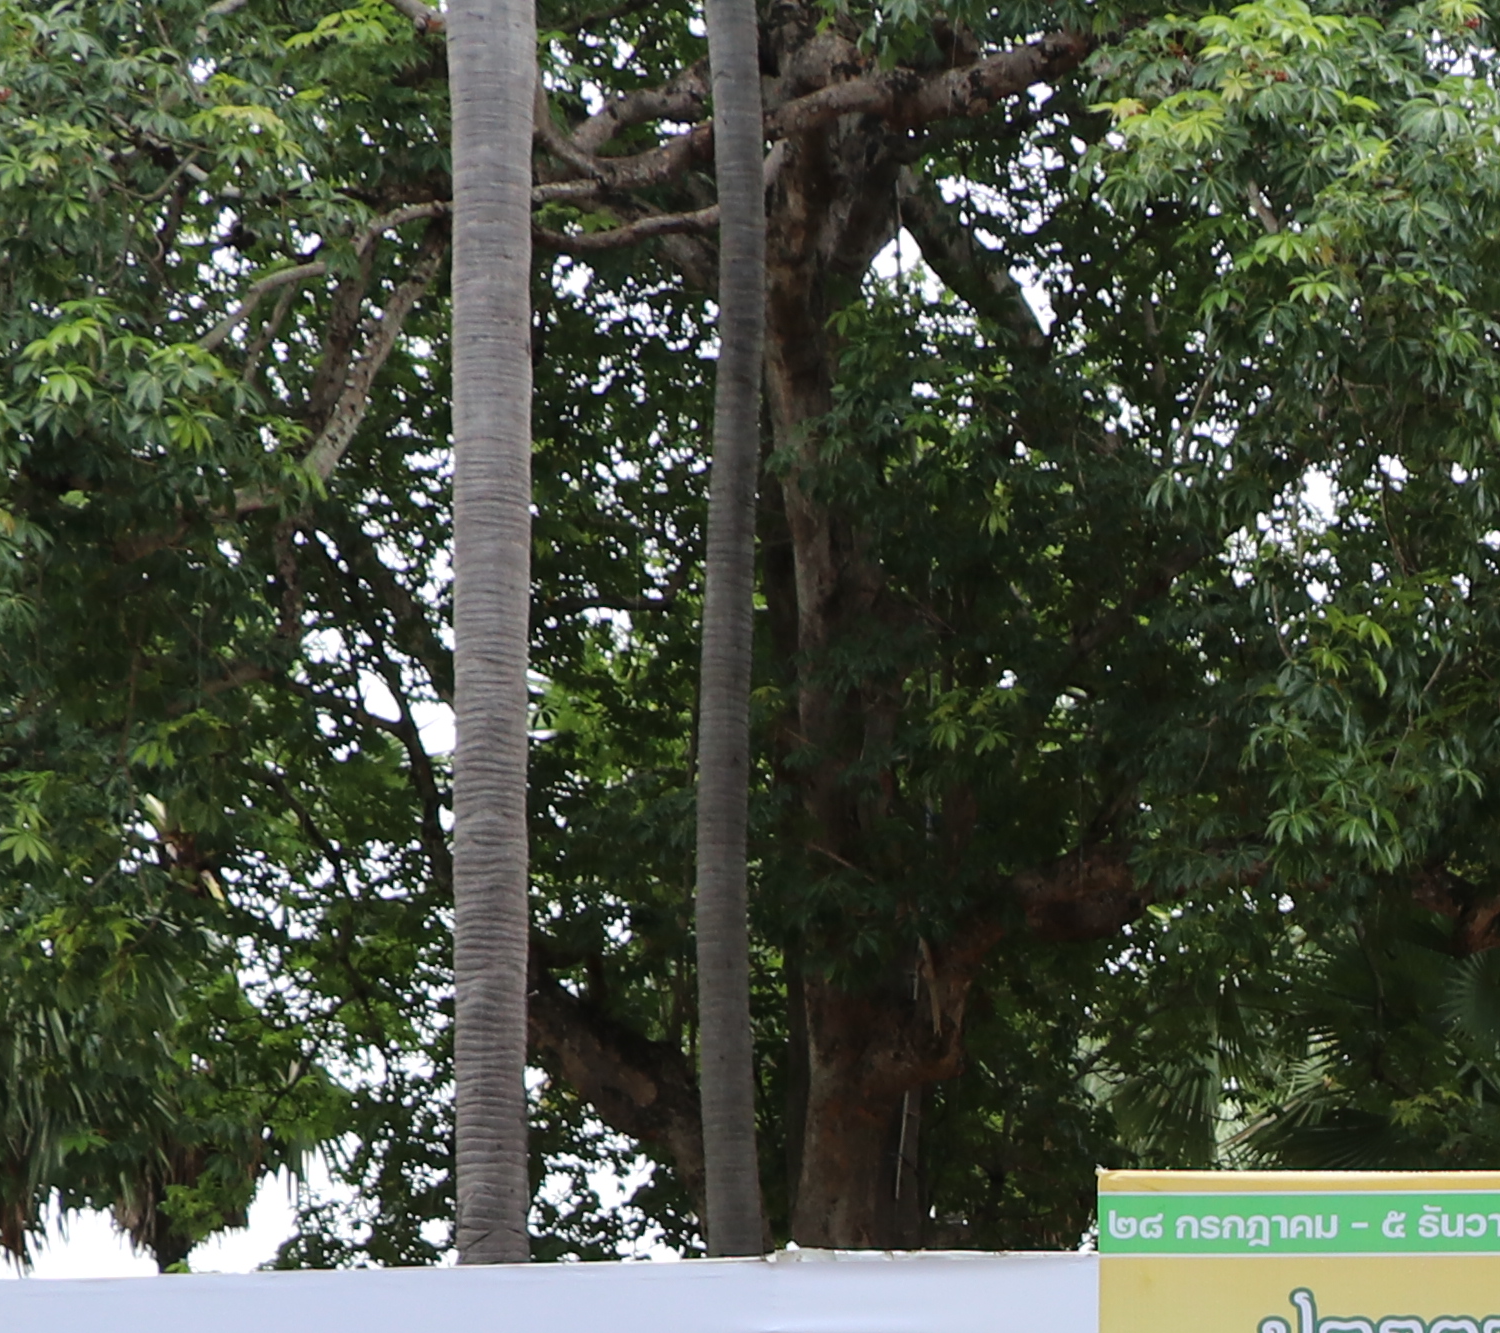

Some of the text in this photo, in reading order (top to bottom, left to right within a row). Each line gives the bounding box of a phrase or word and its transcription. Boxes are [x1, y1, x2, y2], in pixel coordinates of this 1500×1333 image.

[1107, 1210, 1164, 1237] ๒๘
[1176, 1211, 1337, 1247] กรกฎาคม
[1381, 1212, 1406, 1238] ๕
